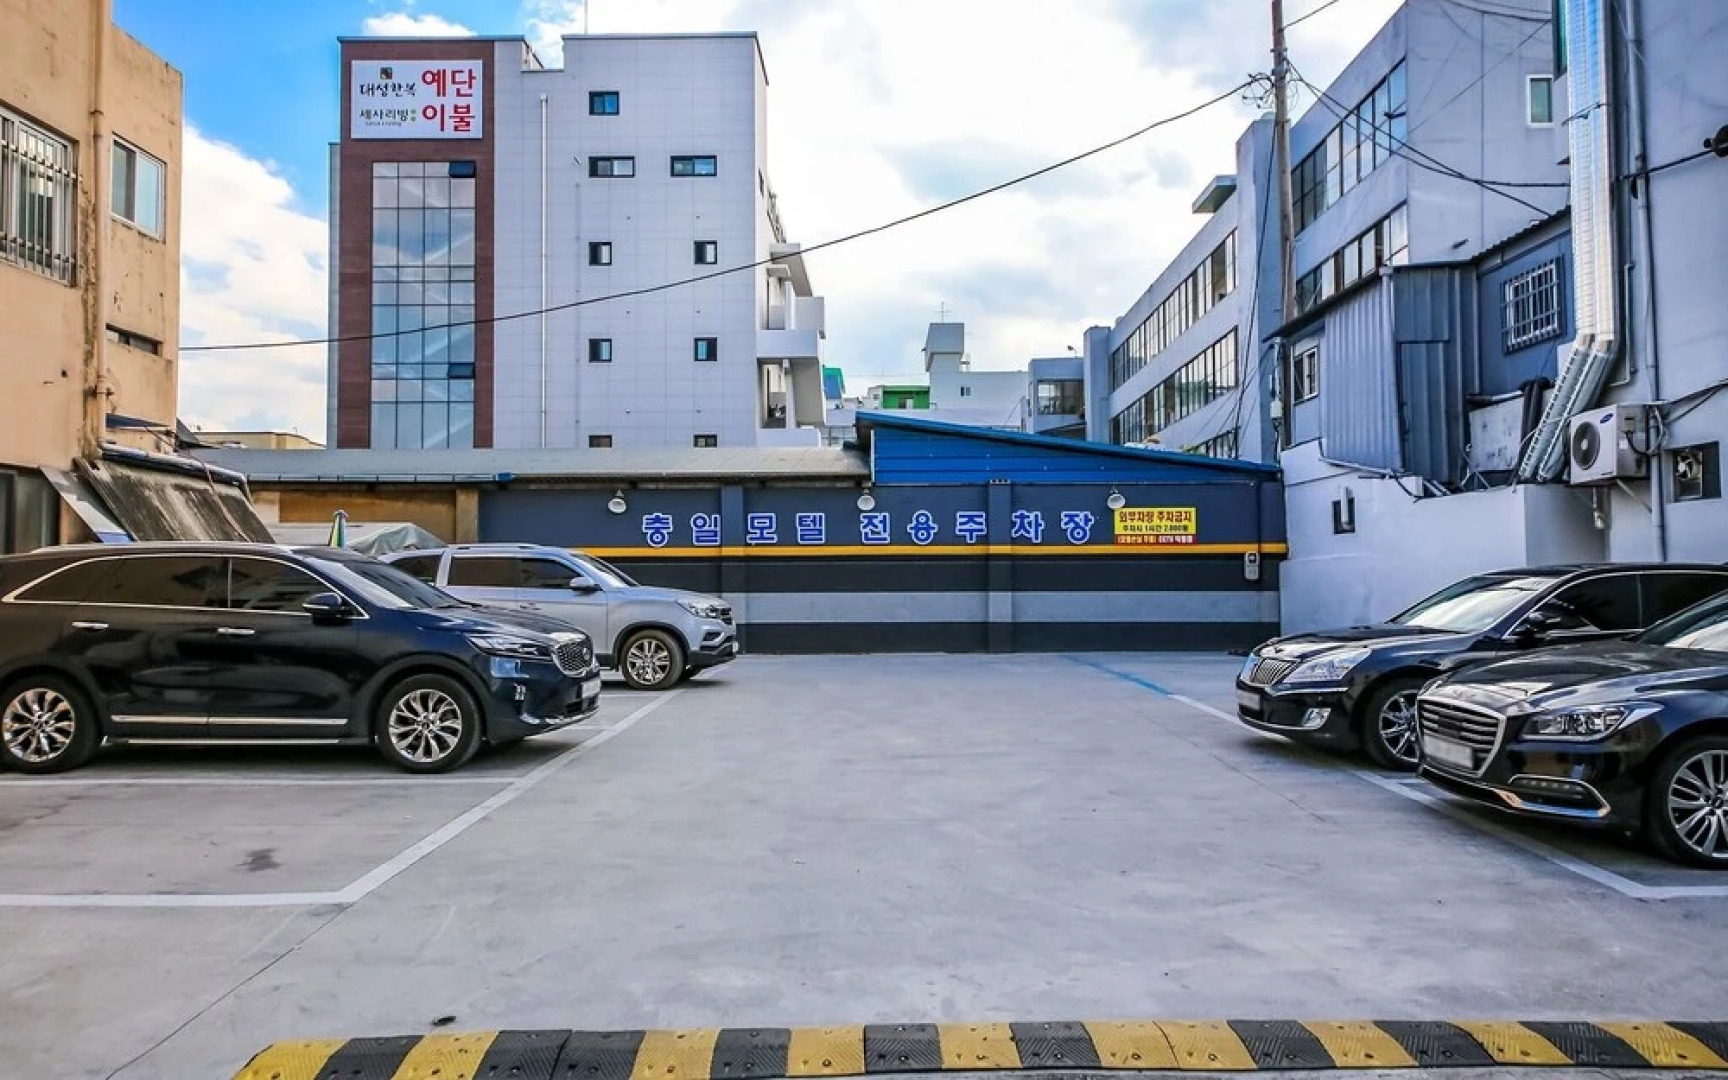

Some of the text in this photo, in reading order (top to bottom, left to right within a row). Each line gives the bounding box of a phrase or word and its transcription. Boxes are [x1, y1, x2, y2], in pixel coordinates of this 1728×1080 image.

[360, 82, 416, 97] 대성한복
[421, 68, 477, 97] 예단
[422, 103, 476, 132] 이불
[642, 509, 1094, 547] 충일모텔 전용주차장
[1157, 510, 1192, 522] 주차금지
